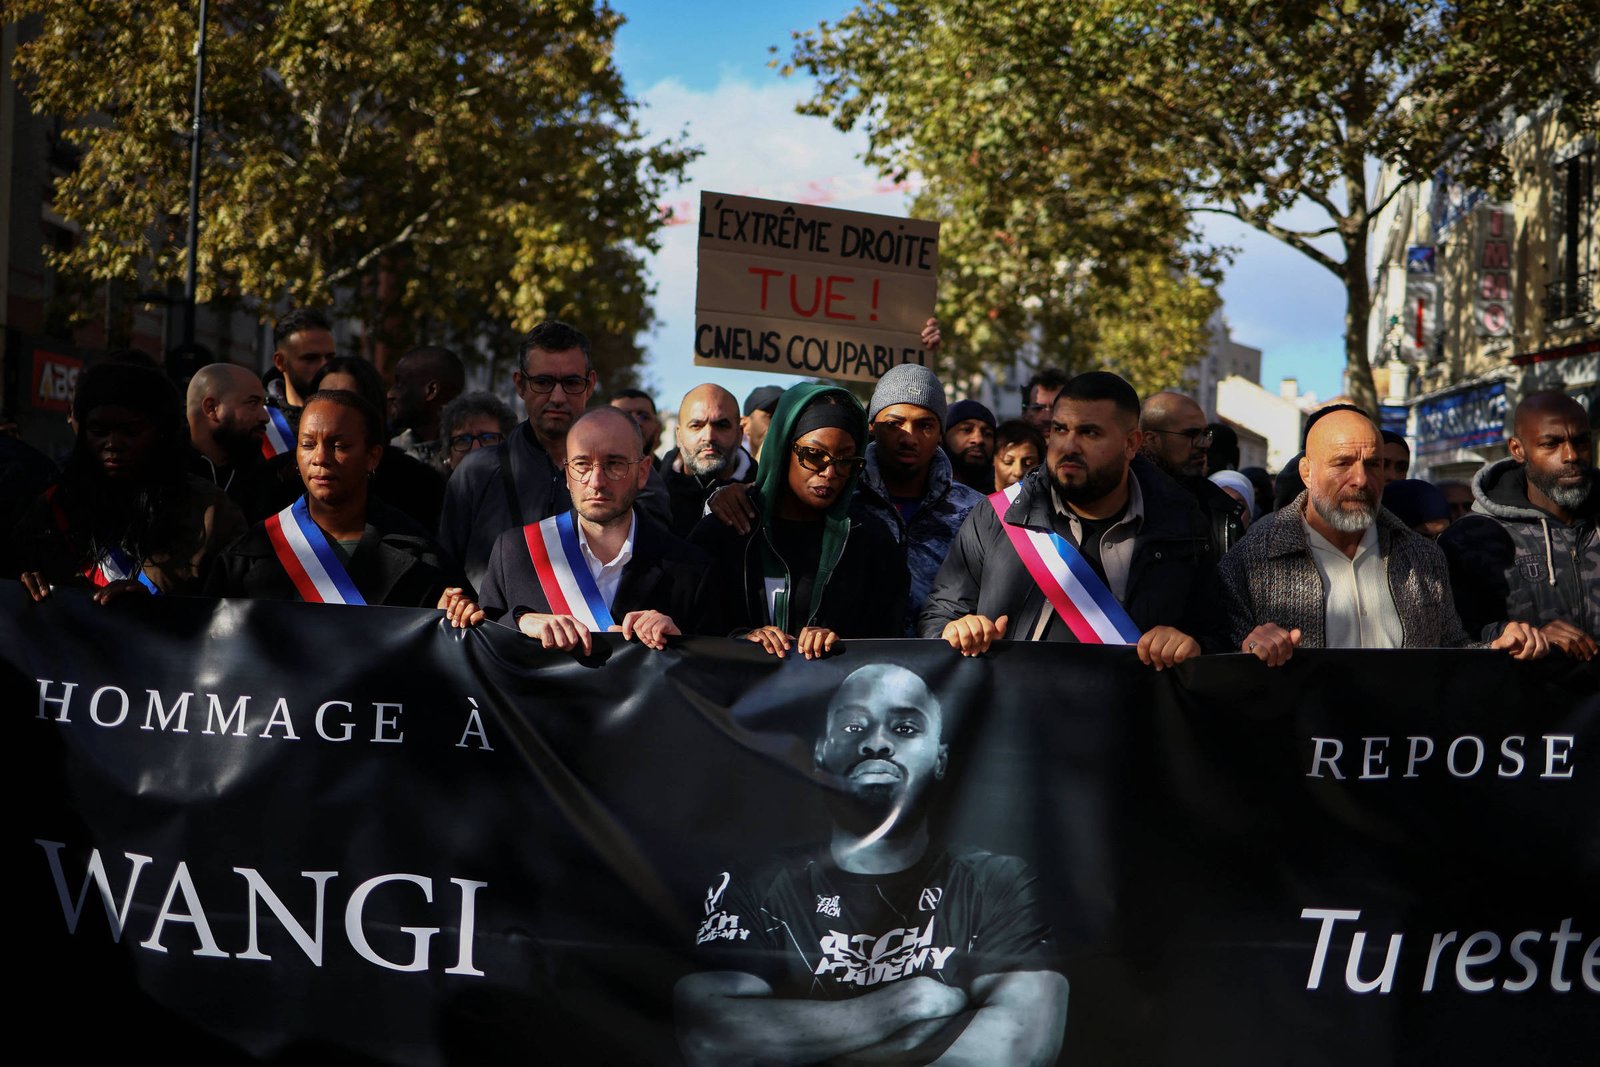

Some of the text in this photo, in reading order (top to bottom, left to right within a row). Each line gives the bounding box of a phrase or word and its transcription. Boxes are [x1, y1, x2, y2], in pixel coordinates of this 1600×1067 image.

[700, 198, 832, 253] L'EXTRÊME
[748, 267, 857, 321] TUE
[696, 324, 781, 363] CNEWS
[36, 678, 495, 751] HOMMAGE À
[1305, 735, 1575, 780] REPOSE
[34, 838, 488, 977] WANGI
[1301, 908, 1404, 994] Tu
